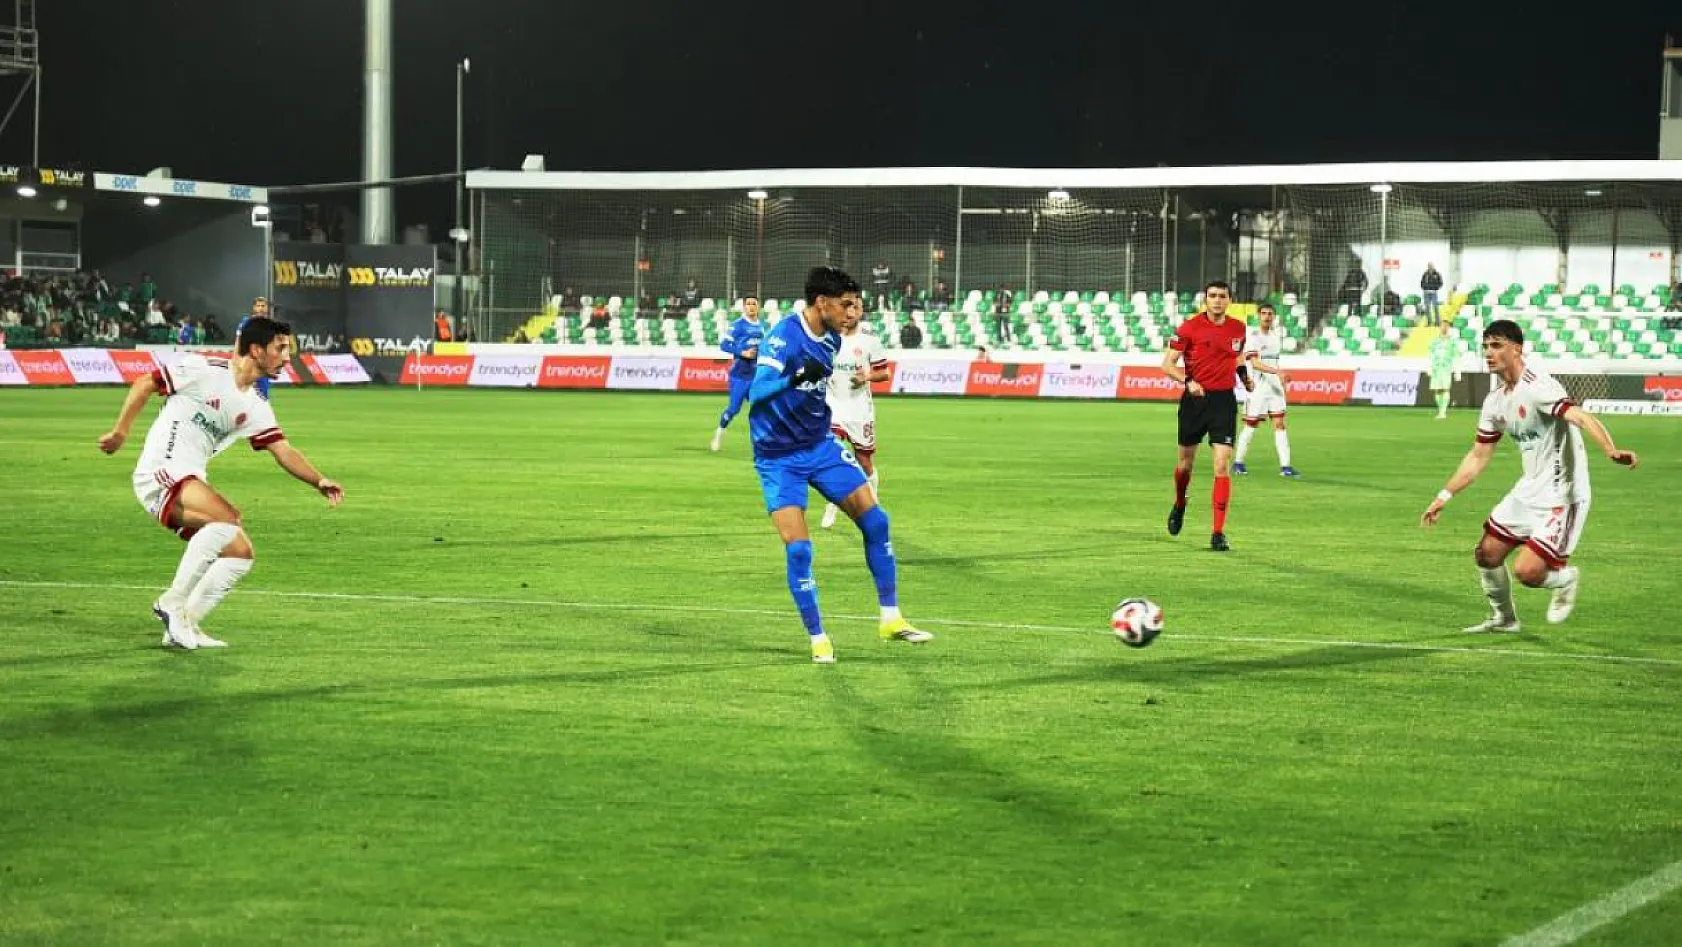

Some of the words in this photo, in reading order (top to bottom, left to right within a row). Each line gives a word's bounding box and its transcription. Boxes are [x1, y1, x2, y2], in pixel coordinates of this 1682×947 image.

[297, 260, 343, 277] TALAY
[374, 267, 433, 281] TALAY
[408, 362, 468, 377] trendyol
[479, 363, 537, 377] trendyol
[546, 364, 605, 378] trendyol
[615, 364, 675, 379] trendyol
[901, 369, 962, 384] trendyol
[1049, 374, 1114, 389] trendyol
[1286, 379, 1348, 395] rendyol
